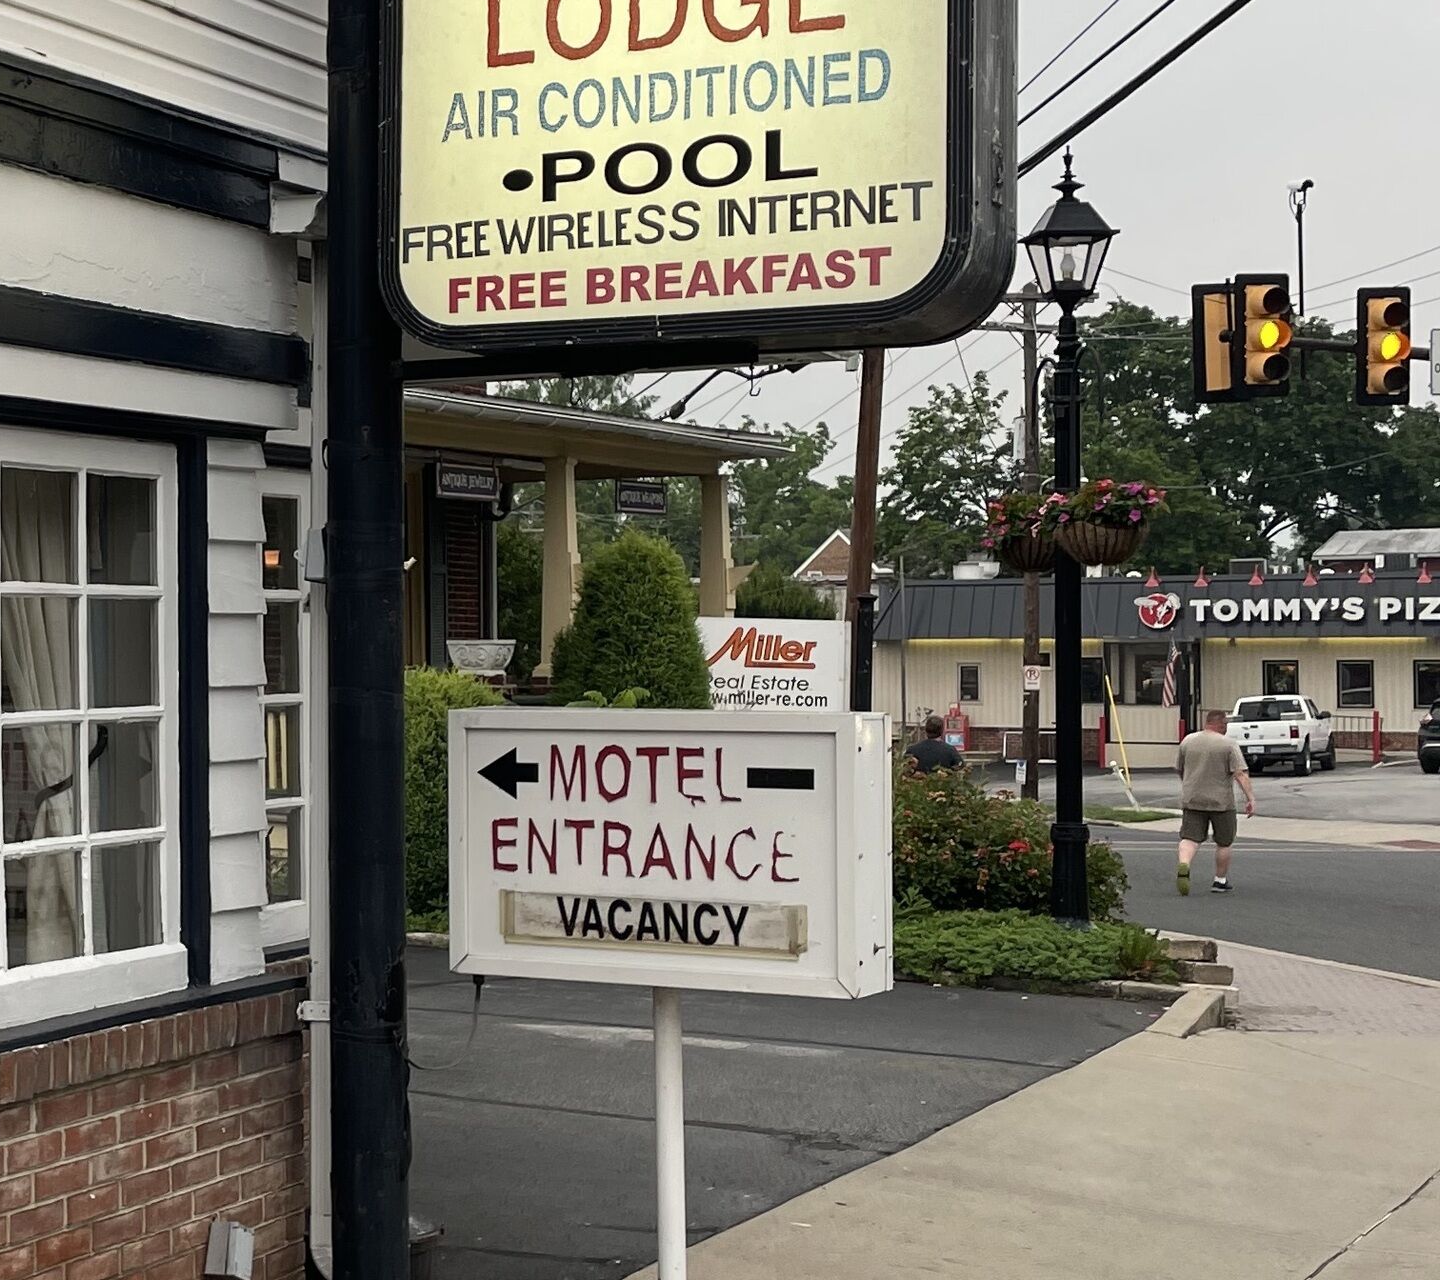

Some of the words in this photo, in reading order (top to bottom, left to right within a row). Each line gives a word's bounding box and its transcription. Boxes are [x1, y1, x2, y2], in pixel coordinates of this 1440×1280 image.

[441, 87, 519, 142] AIR
[538, 48, 891, 133] CONDITIONED
[542, 129, 819, 202] POOL
[402, 220, 490, 264] FREE
[496, 200, 700, 255] WIRELESS
[717, 181, 934, 237] INTERNET
[448, 270, 567, 313] FREE
[586, 246, 893, 304] BREAKFAST
[1189, 596, 1365, 622] TOMMY'S
[705, 626, 817, 669] Miller
[709, 675, 745, 689] eal
[751, 675, 809, 691] Estate
[550, 744, 742, 807] MOTEL
[491, 817, 799, 882] ENTRANCE
[557, 896, 750, 946] VACANCY
